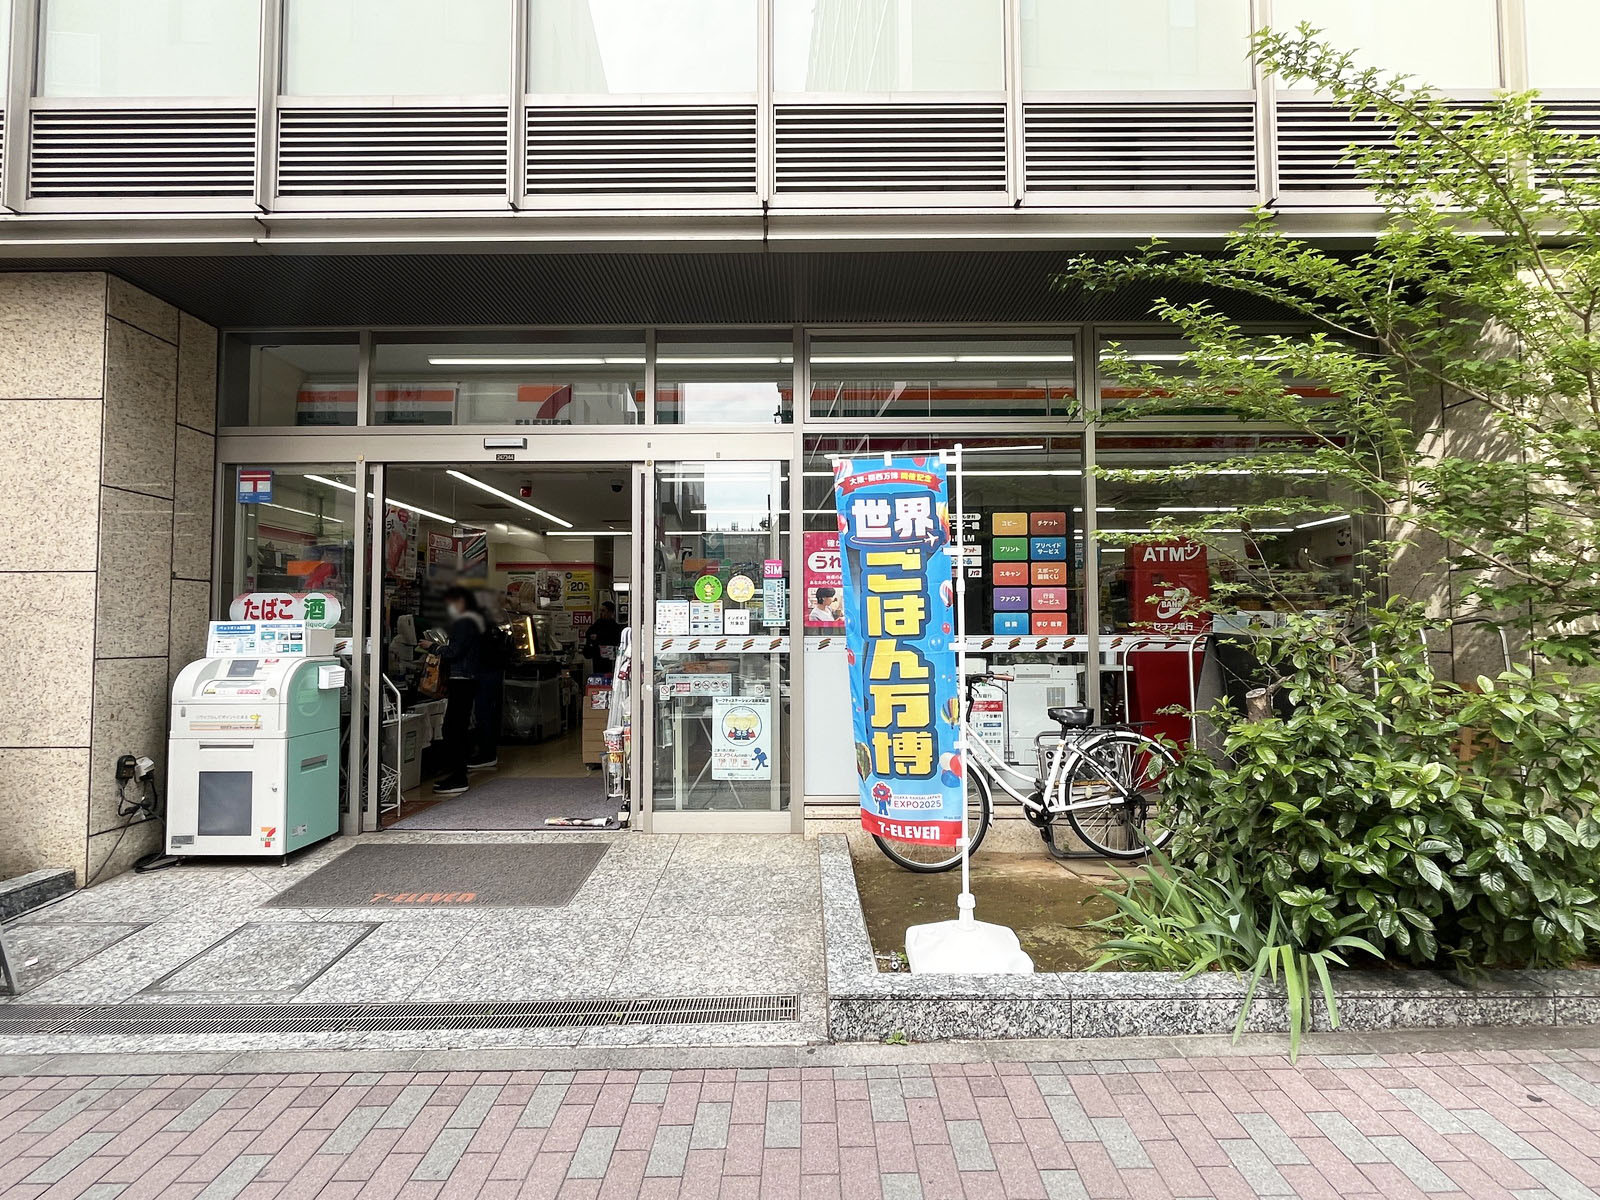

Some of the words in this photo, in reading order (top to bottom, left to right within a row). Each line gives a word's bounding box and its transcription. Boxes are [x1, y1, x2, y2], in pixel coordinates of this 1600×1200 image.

[851, 496, 934, 538] 世界
[1142, 546, 1185, 562] ATM
[764, 565, 783, 575] SIM
[243, 597, 294, 620] たばこ
[303, 598, 326, 620] 酒
[573, 615, 592, 624] SIM
[865, 547, 933, 776] ごはん万博
[893, 800, 942, 809] EXPO2025
